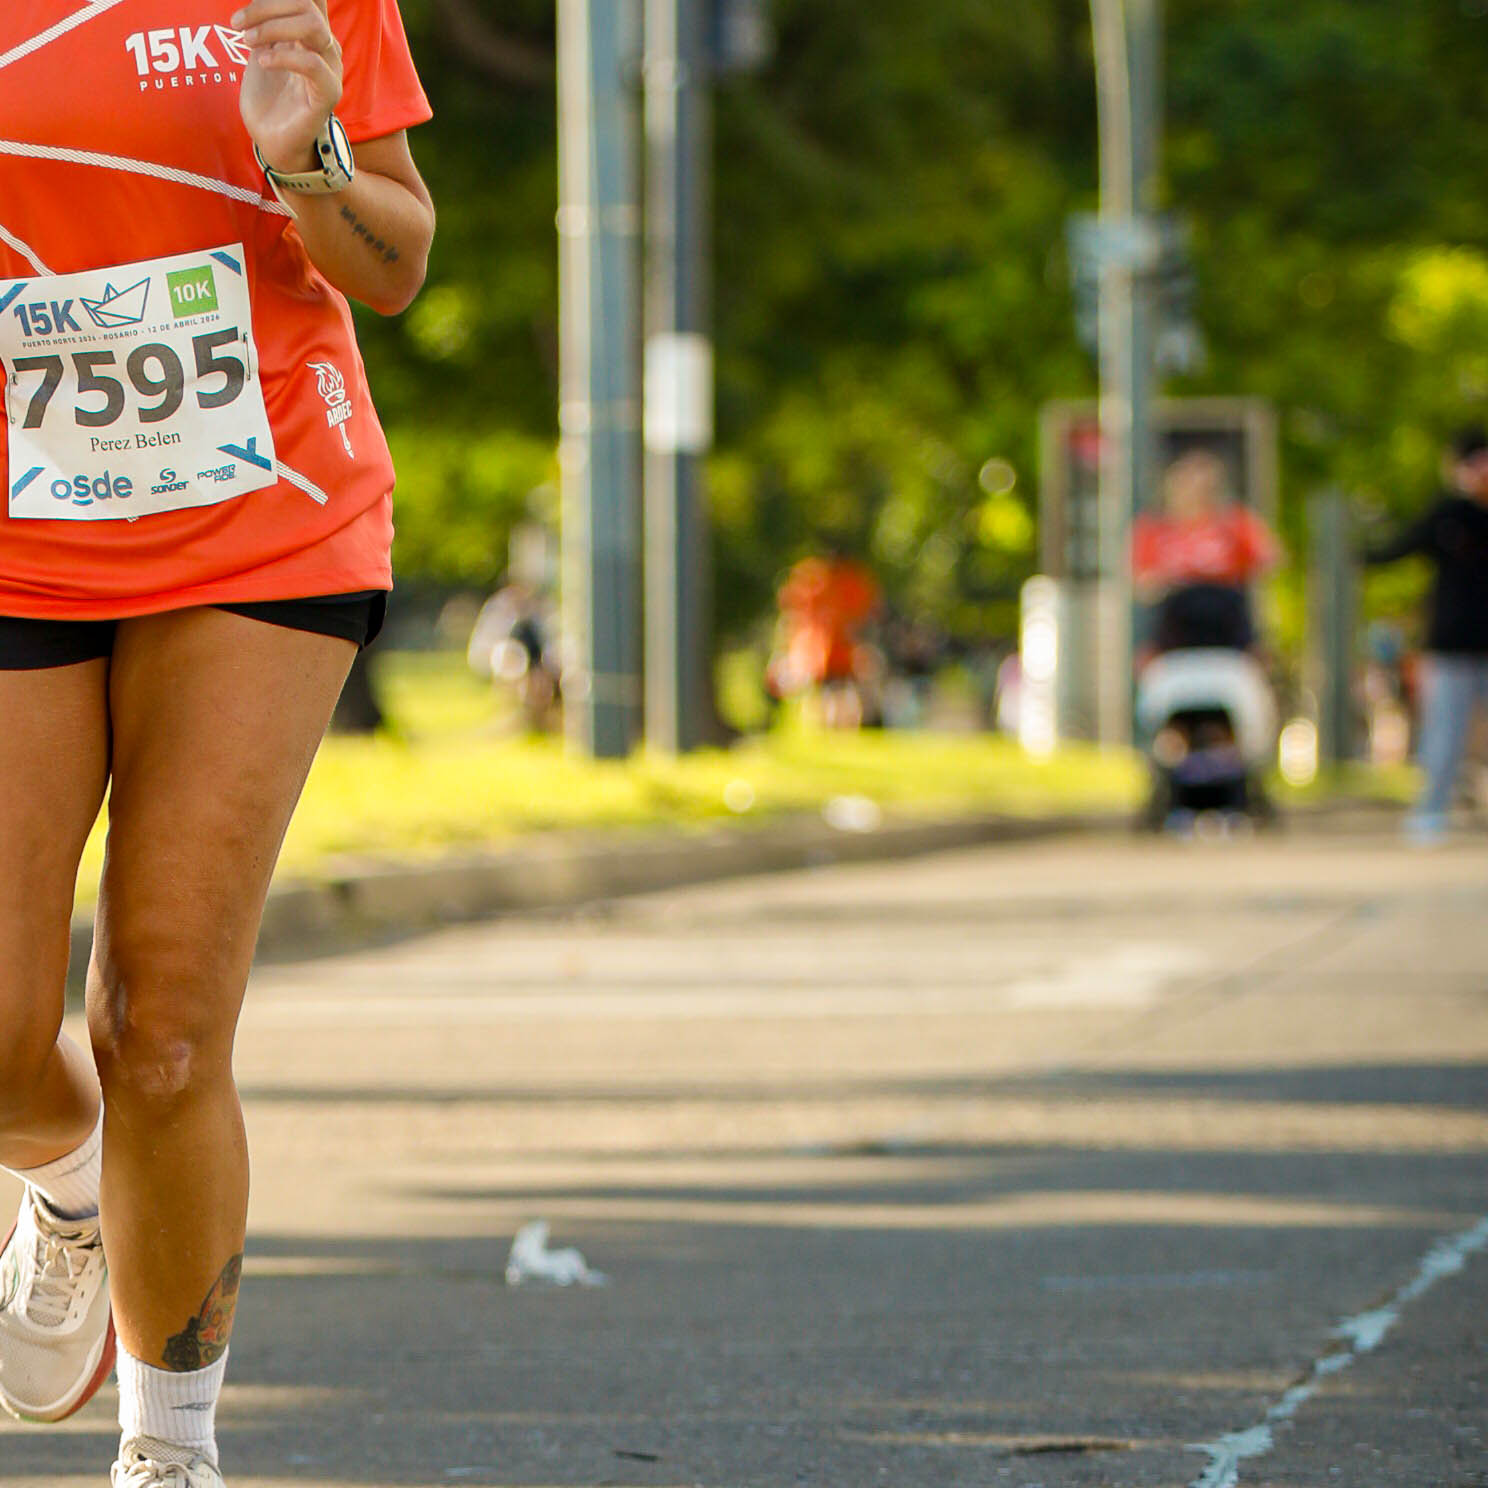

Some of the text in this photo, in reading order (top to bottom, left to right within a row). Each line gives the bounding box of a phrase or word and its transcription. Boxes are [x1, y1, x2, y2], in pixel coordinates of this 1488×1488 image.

[124, 24, 220, 77] 15K
[172, 279, 213, 305] 10K
[13, 298, 82, 338] 15K
[22, 339, 51, 349] PUERTO
[11, 326, 245, 430] 7595
[90, 431, 182, 452] Perez Belen
[50, 470, 134, 501] osde
